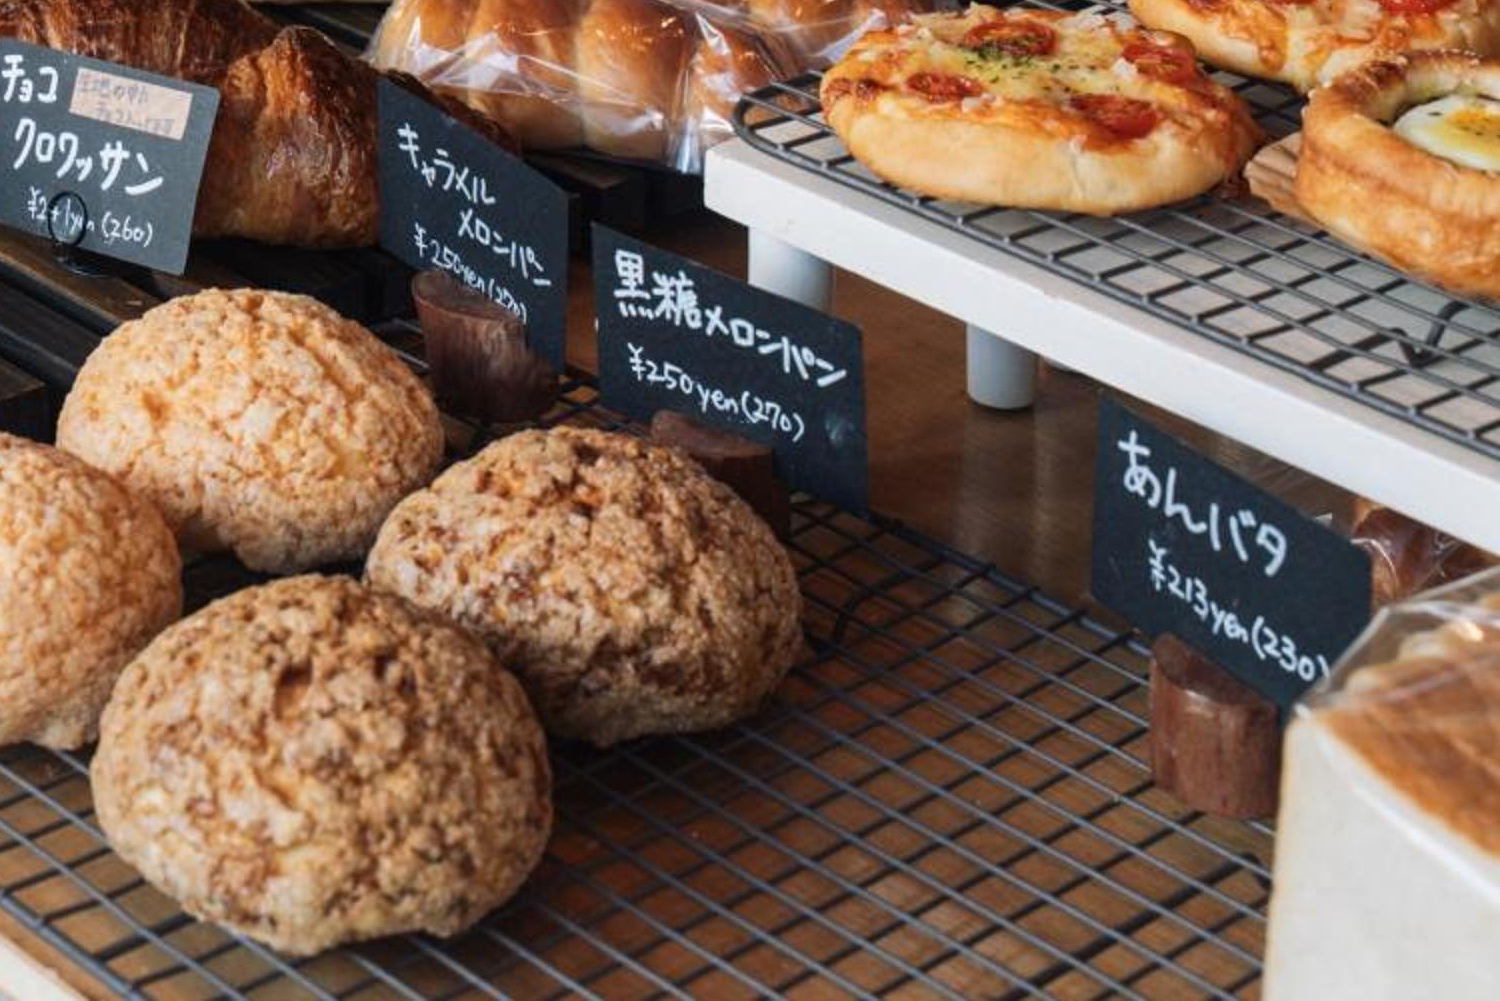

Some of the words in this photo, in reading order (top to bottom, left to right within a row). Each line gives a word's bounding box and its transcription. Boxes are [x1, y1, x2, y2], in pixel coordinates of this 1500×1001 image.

[1, 54, 59, 103] チョコ
[13, 117, 164, 196] クロワッサン
[398, 122, 496, 204] キャラメル
[457, 208, 552, 286] メロンパン
[614, 249, 847, 388] 黒糖メロンパン
[1117, 429, 1288, 577] あんバタ
